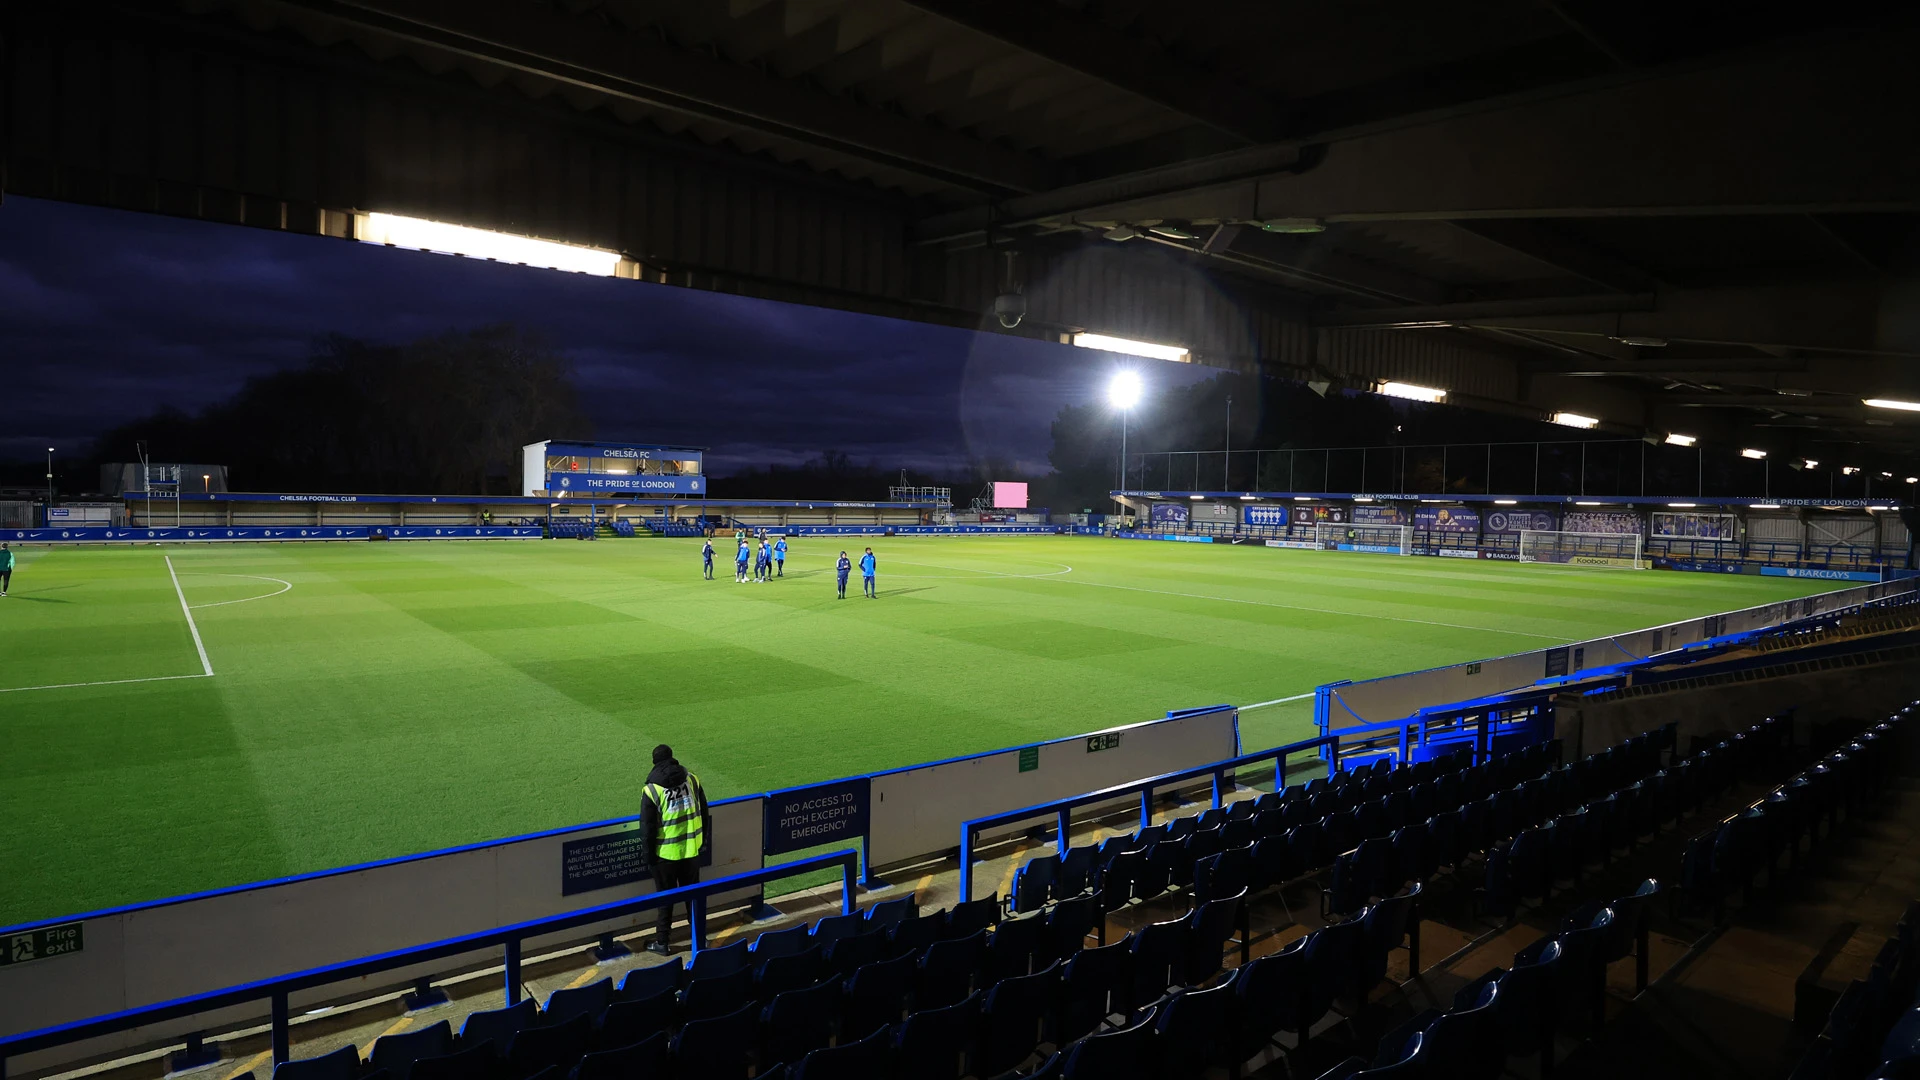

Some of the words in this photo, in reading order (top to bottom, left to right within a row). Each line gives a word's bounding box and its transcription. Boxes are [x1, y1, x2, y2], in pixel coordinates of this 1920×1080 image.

[604, 450, 638, 458] CHELSEA
[640, 451, 650, 459] FC
[605, 480, 630, 488] PRIDE
[1799, 569, 1850, 579] BARCLAYS
[665, 784, 689, 801] 221
[785, 804, 799, 814] NO
[802, 796, 838, 811] ACCESS
[841, 793, 853, 803] TO
[780, 815, 808, 828] PITCH
[811, 807, 845, 822] EXCEPT
[848, 805, 857, 815] IN
[792, 820, 847, 839] EMERGENCY
[567, 854, 593, 864] ABUSIVE
[595, 848, 628, 859] LANGUAGE
[585, 859, 607, 869] RESULT
[616, 853, 639, 862] ARREST
[624, 860, 640, 868] CLUB
[46, 929, 76, 942] Fire
[46, 940, 76, 954] exit
